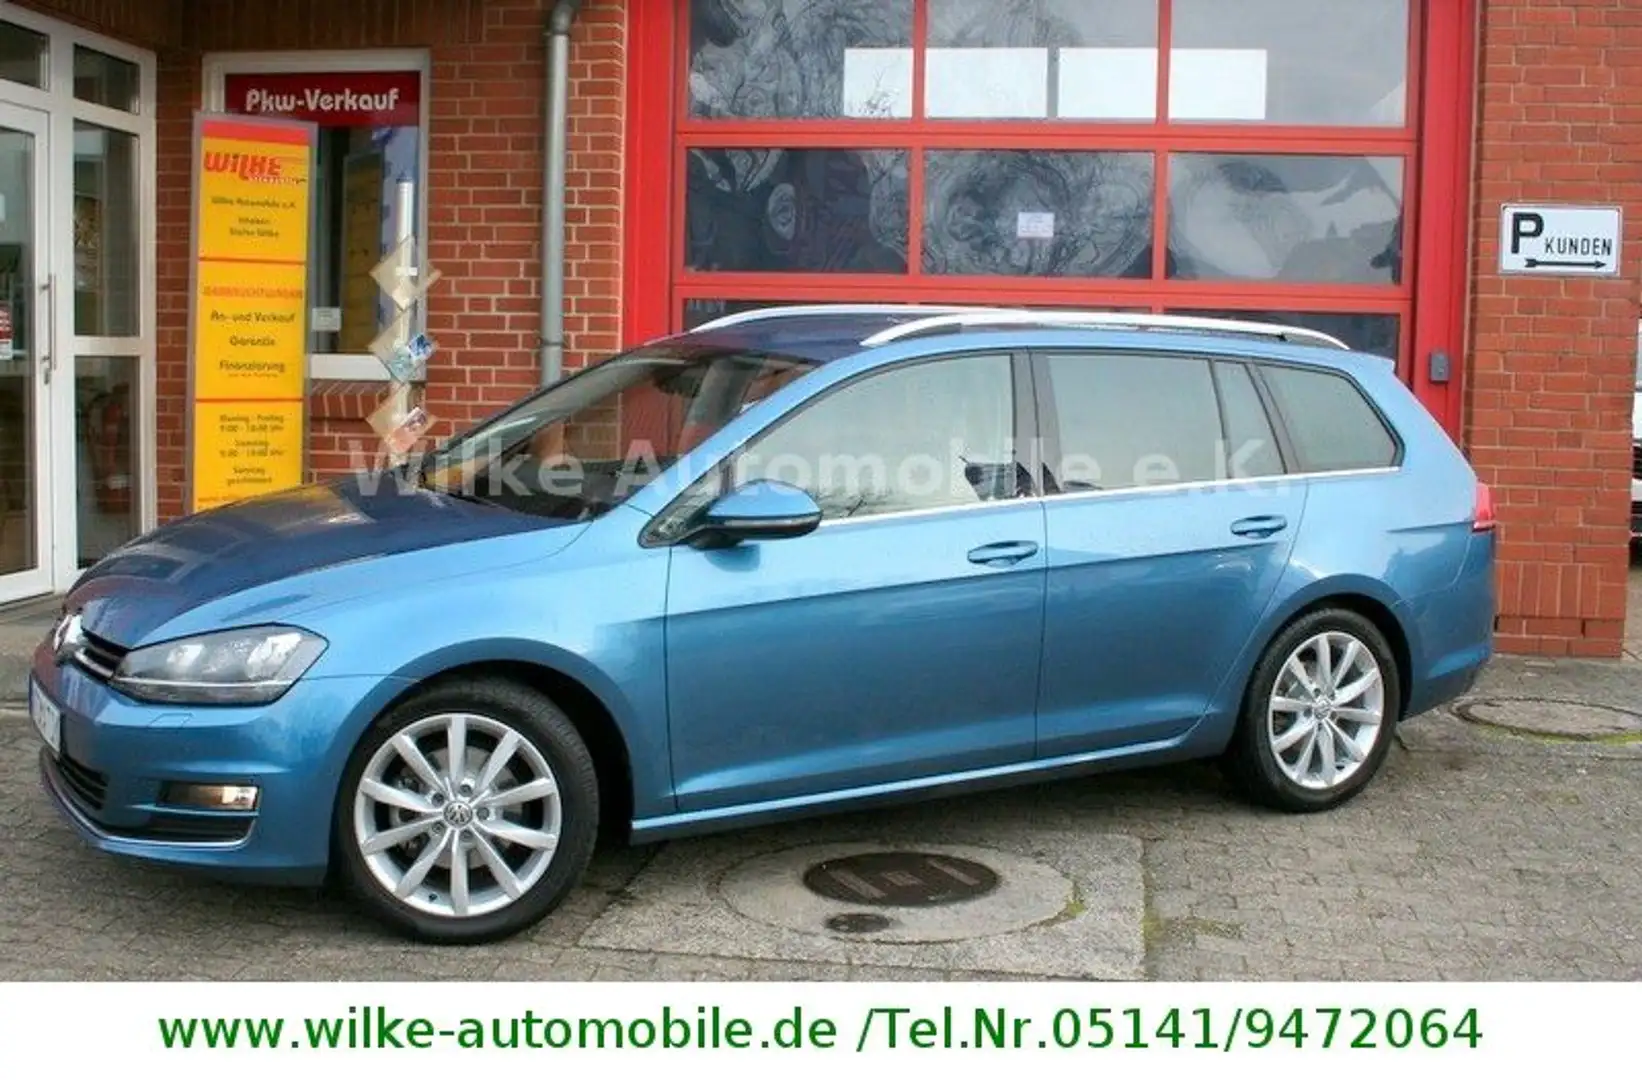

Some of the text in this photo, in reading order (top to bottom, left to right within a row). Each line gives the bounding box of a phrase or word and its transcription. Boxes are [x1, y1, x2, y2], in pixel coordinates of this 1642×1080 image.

[246, 88, 399, 111] Pkw-Verkauf
[1511, 212, 1613, 256] P KUNDEN
[254, 311, 295, 323] Verkauf
[229, 335, 276, 346] Garantie
[219, 360, 286, 373] Finanzierung
